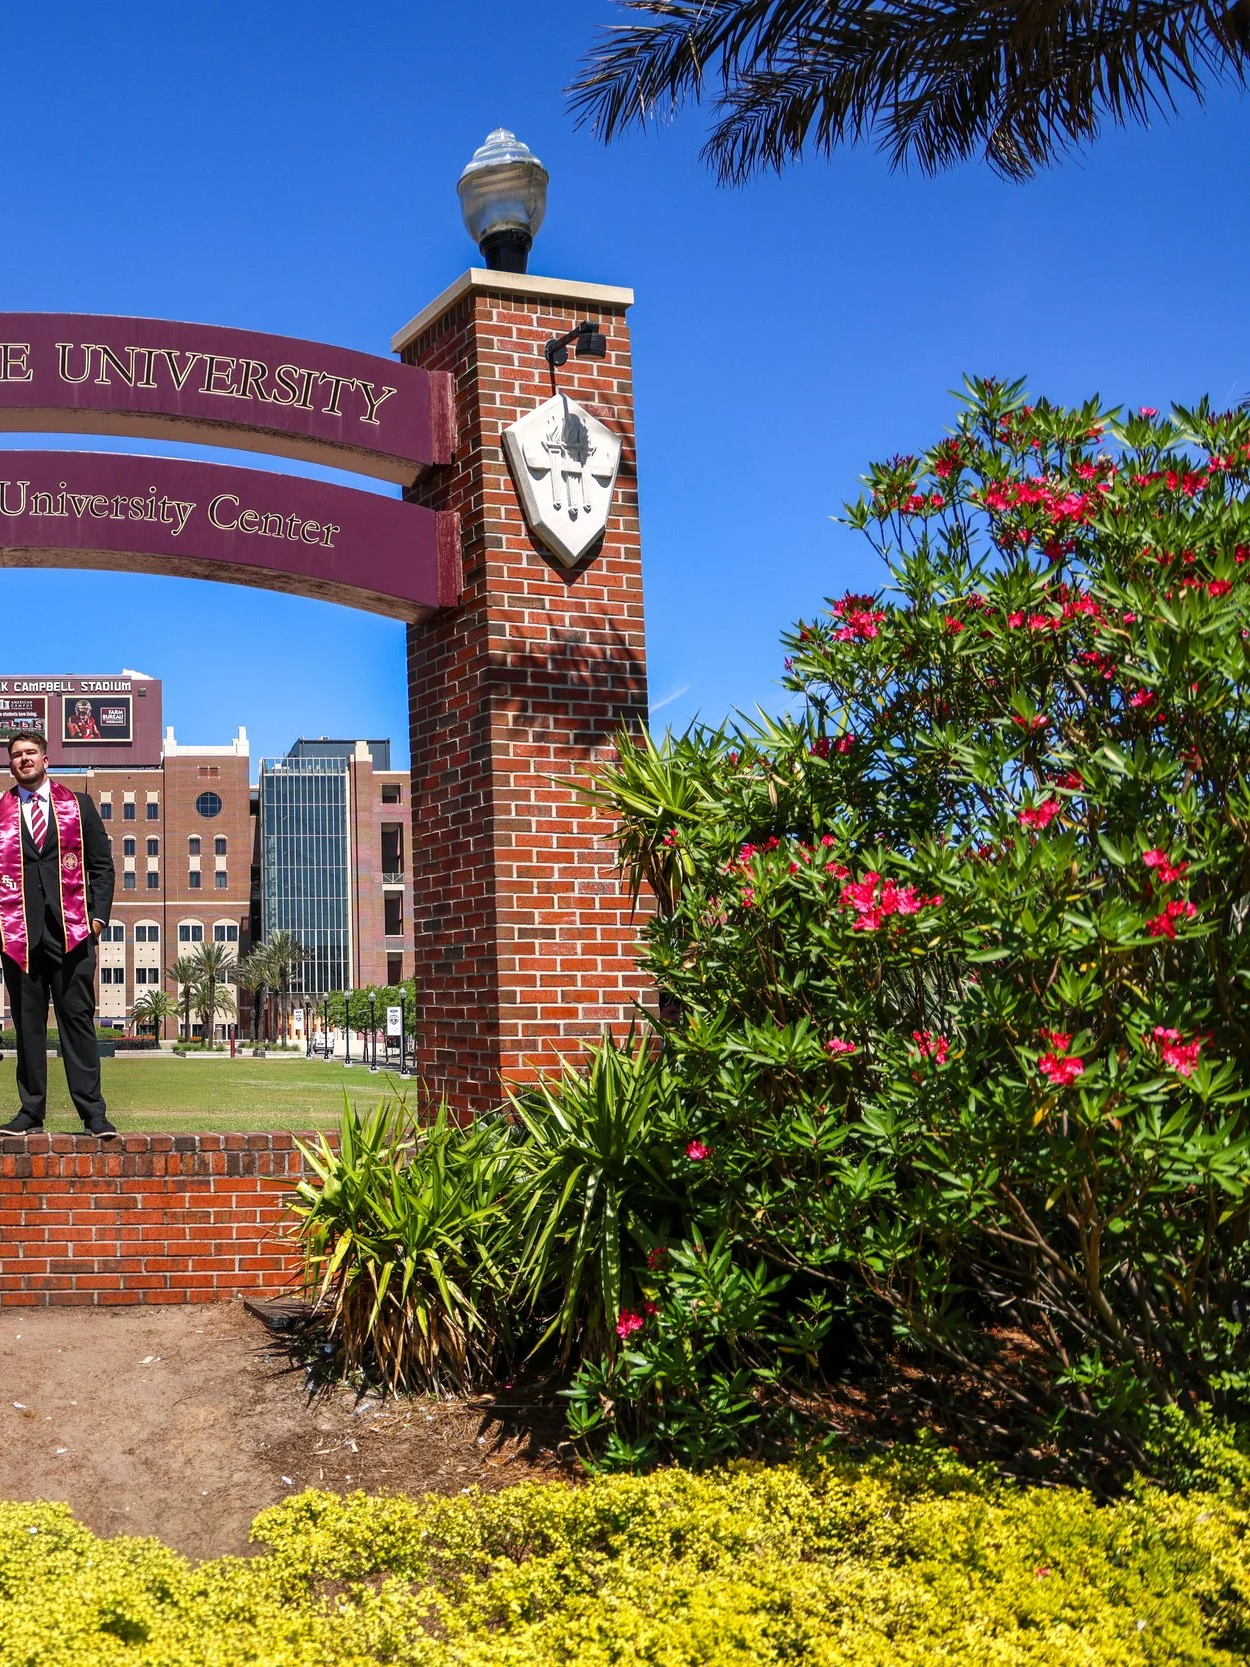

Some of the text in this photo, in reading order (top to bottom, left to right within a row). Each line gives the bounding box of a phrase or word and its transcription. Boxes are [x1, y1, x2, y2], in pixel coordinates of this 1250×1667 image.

[55, 343, 397, 425] UNIVERSITY
[208, 494, 341, 548] Center
[14, 682, 74, 692] CAMPBELL
[80, 682, 132, 692] STADIUM
[1, 874, 18, 890] FSU
